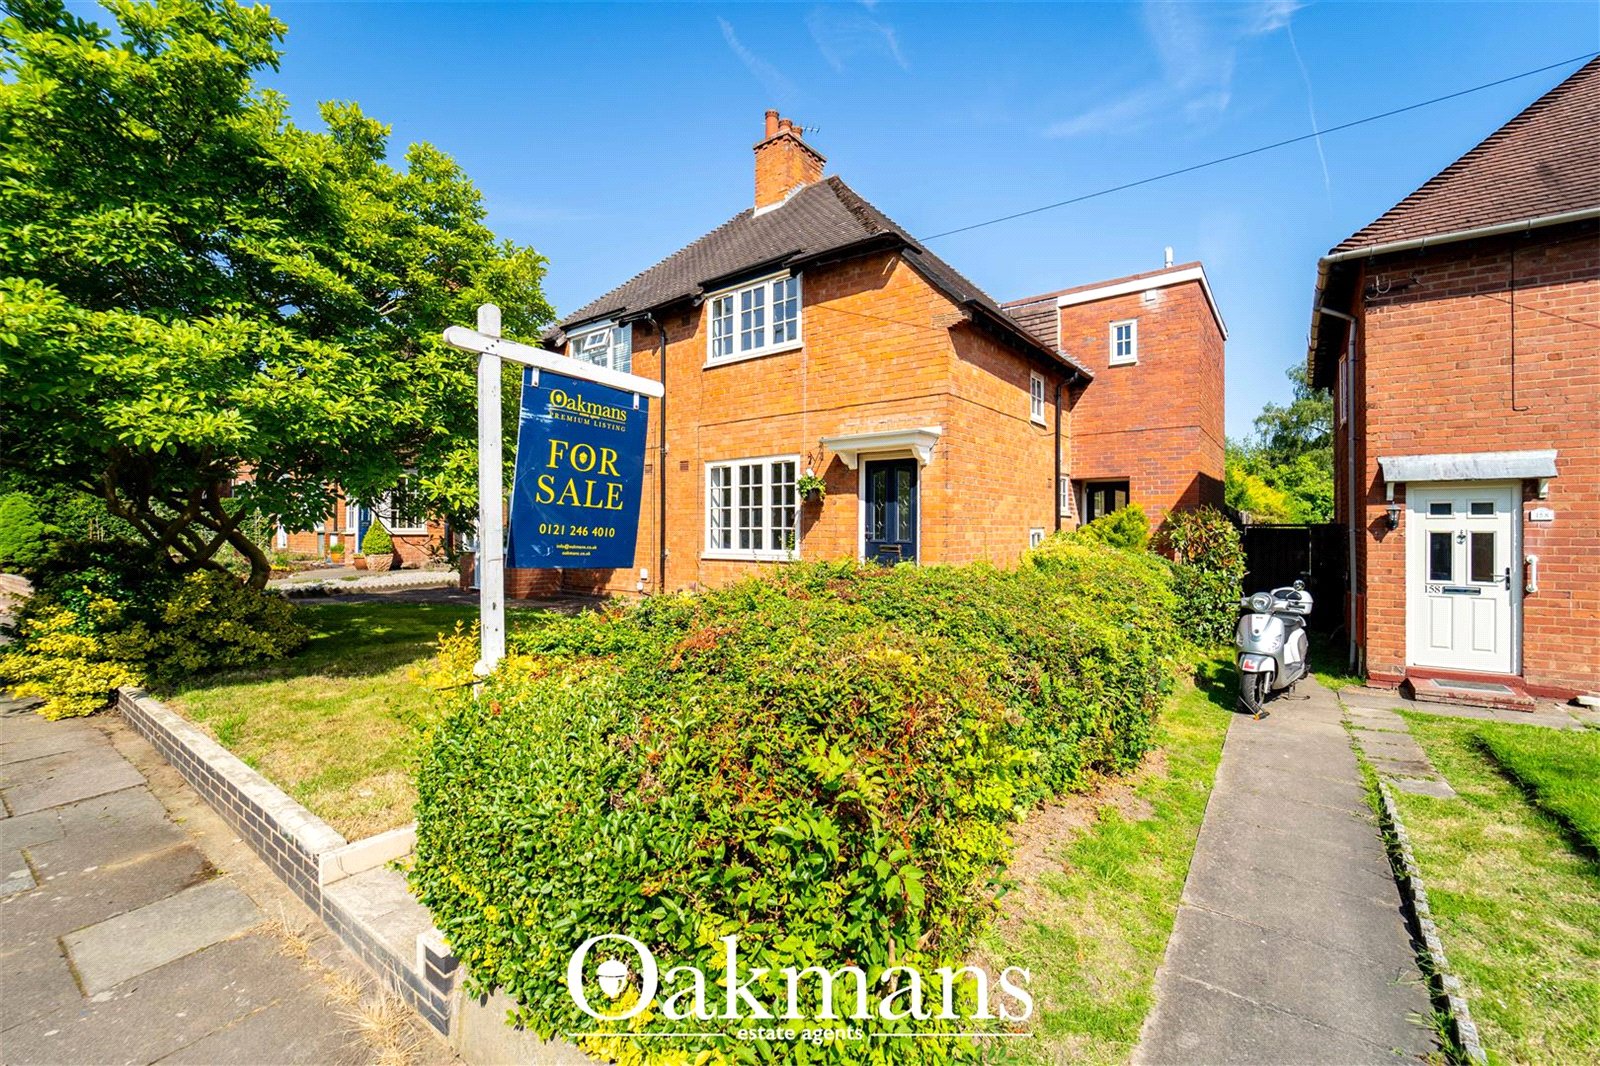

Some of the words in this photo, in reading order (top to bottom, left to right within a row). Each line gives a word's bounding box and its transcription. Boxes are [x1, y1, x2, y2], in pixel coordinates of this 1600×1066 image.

[550, 389, 627, 421] Oakmans
[549, 410, 590, 425] PREMIUM
[593, 420, 626, 432] LISTING
[546, 439, 620, 477] FOR
[536, 474, 623, 510] SALE
[539, 523, 565, 535] 0121
[569, 525, 589, 536] 246
[592, 527, 615, 538] 4010
[1424, 585, 1441, 593] 158
